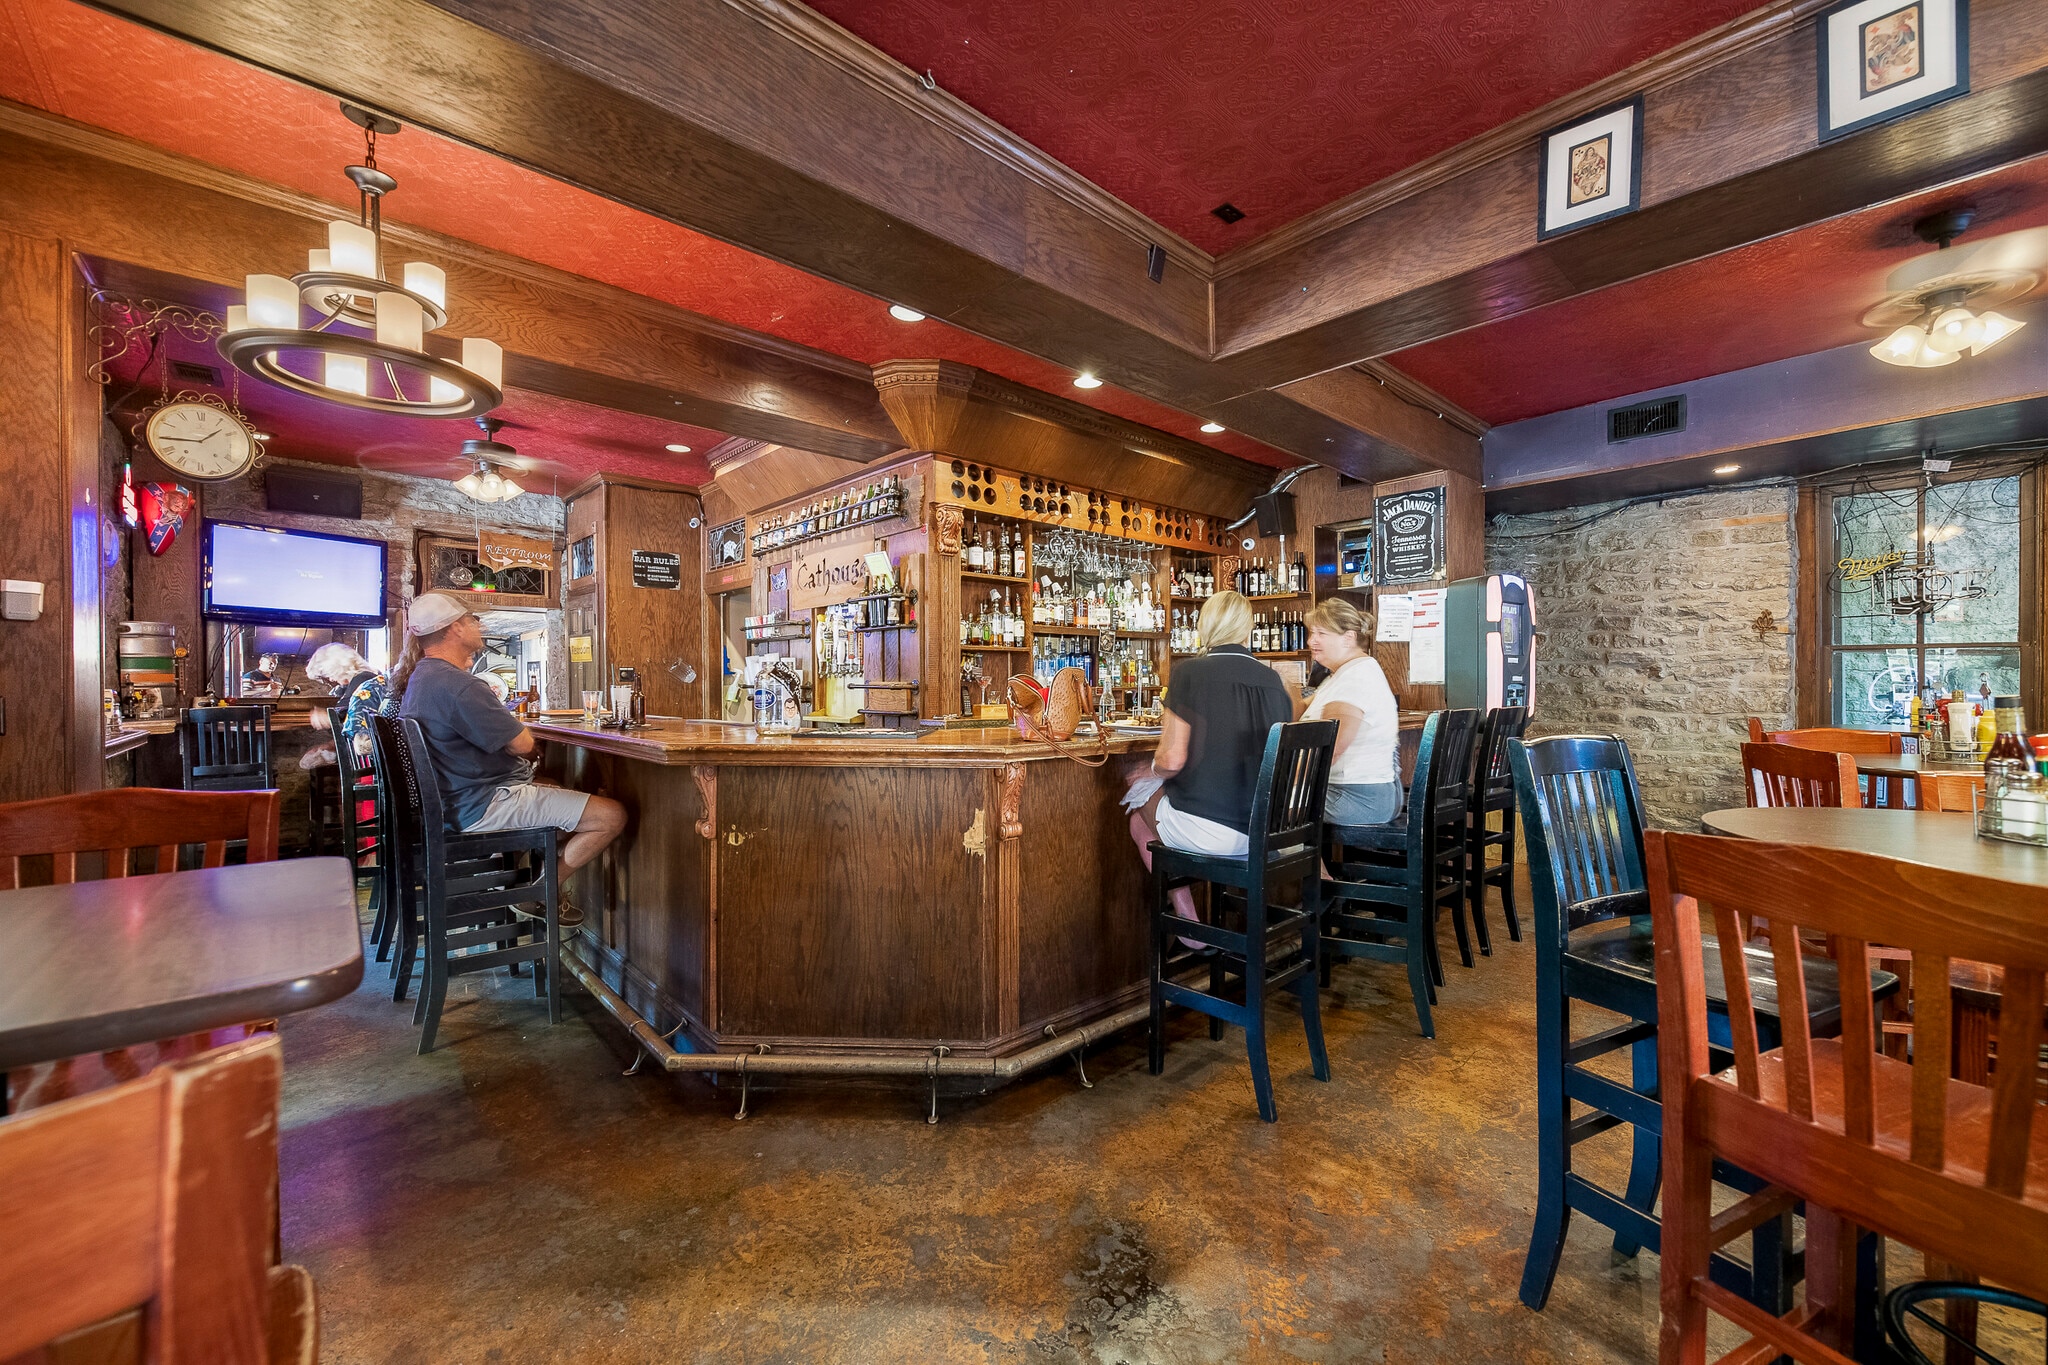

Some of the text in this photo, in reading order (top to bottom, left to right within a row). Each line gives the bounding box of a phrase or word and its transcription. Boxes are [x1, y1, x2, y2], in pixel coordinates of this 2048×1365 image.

[1382, 499, 1437, 521] JACK DANIEL'S
[1391, 534, 1426, 544] Tennessee
[485, 544, 552, 561] RESTROOM
[1392, 543, 1426, 553] WHISKEY
[634, 556, 651, 564] BAR
[653, 558, 679, 566] RULES
[1837, 550, 1907, 580] Miller
